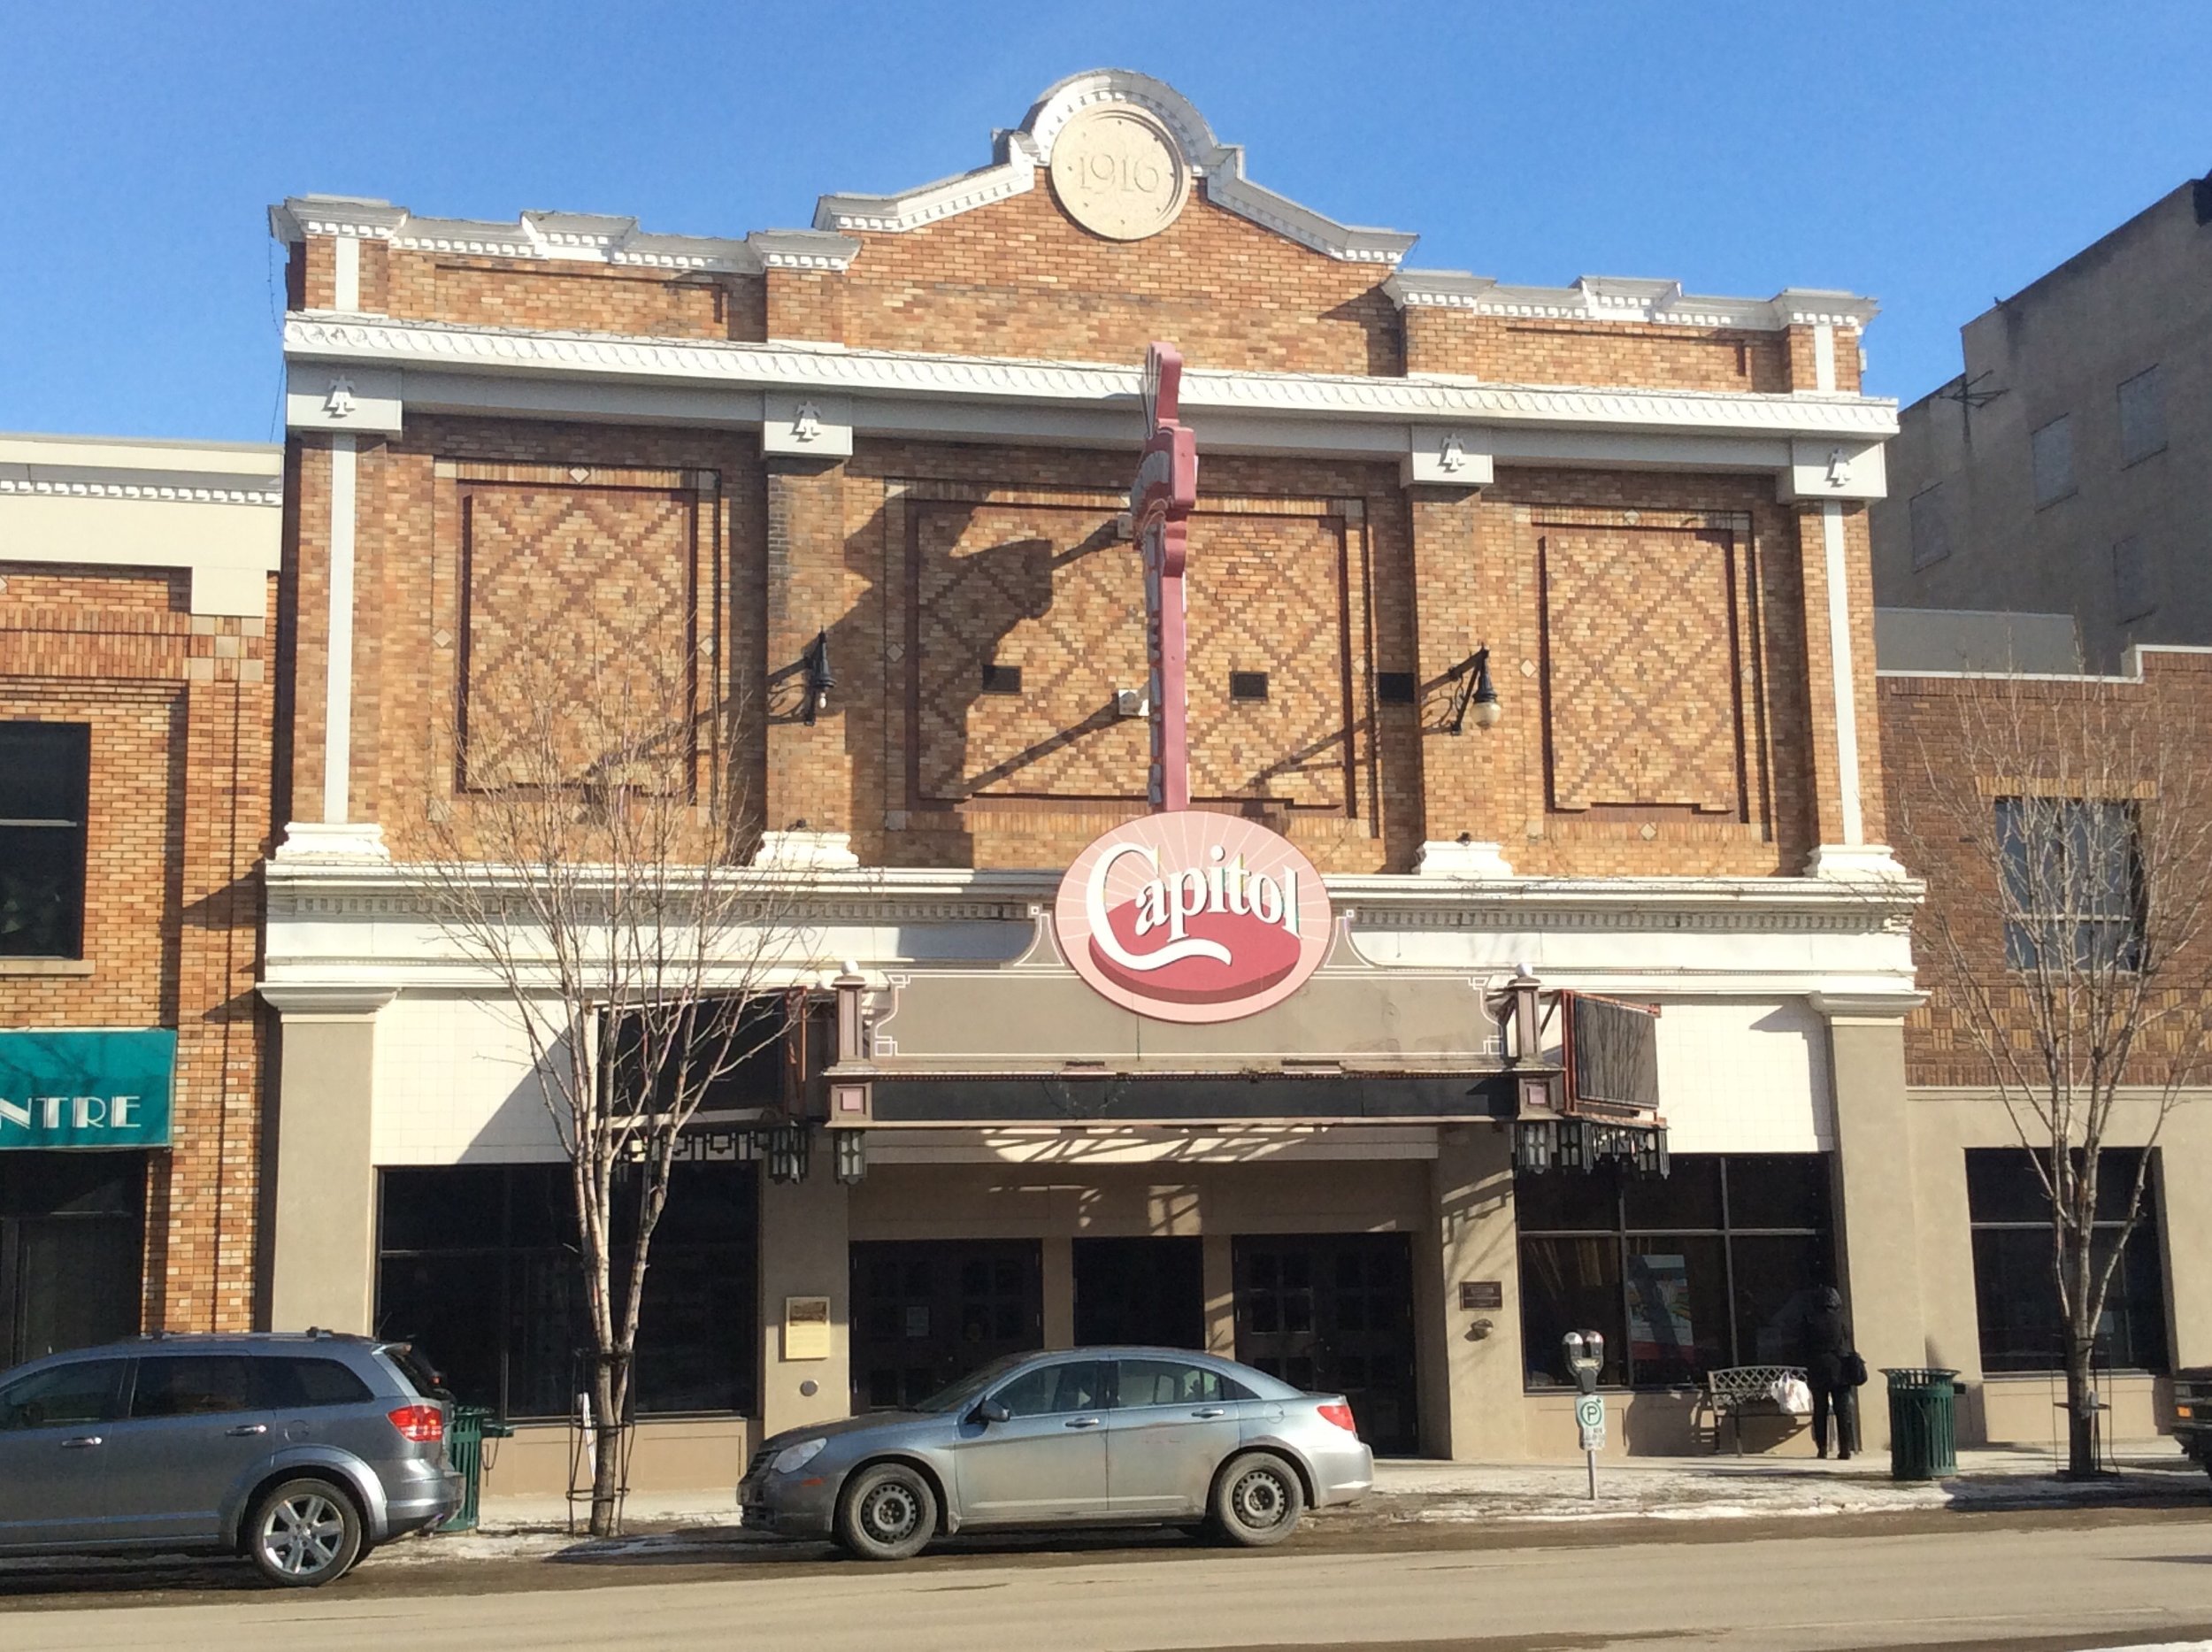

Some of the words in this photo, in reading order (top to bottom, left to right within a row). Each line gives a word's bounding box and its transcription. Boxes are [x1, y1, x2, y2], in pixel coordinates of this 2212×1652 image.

[1086, 842, 1303, 971] Capitol
[0, 1096, 141, 1129] NTRE
[1587, 1406, 1597, 1421] P
